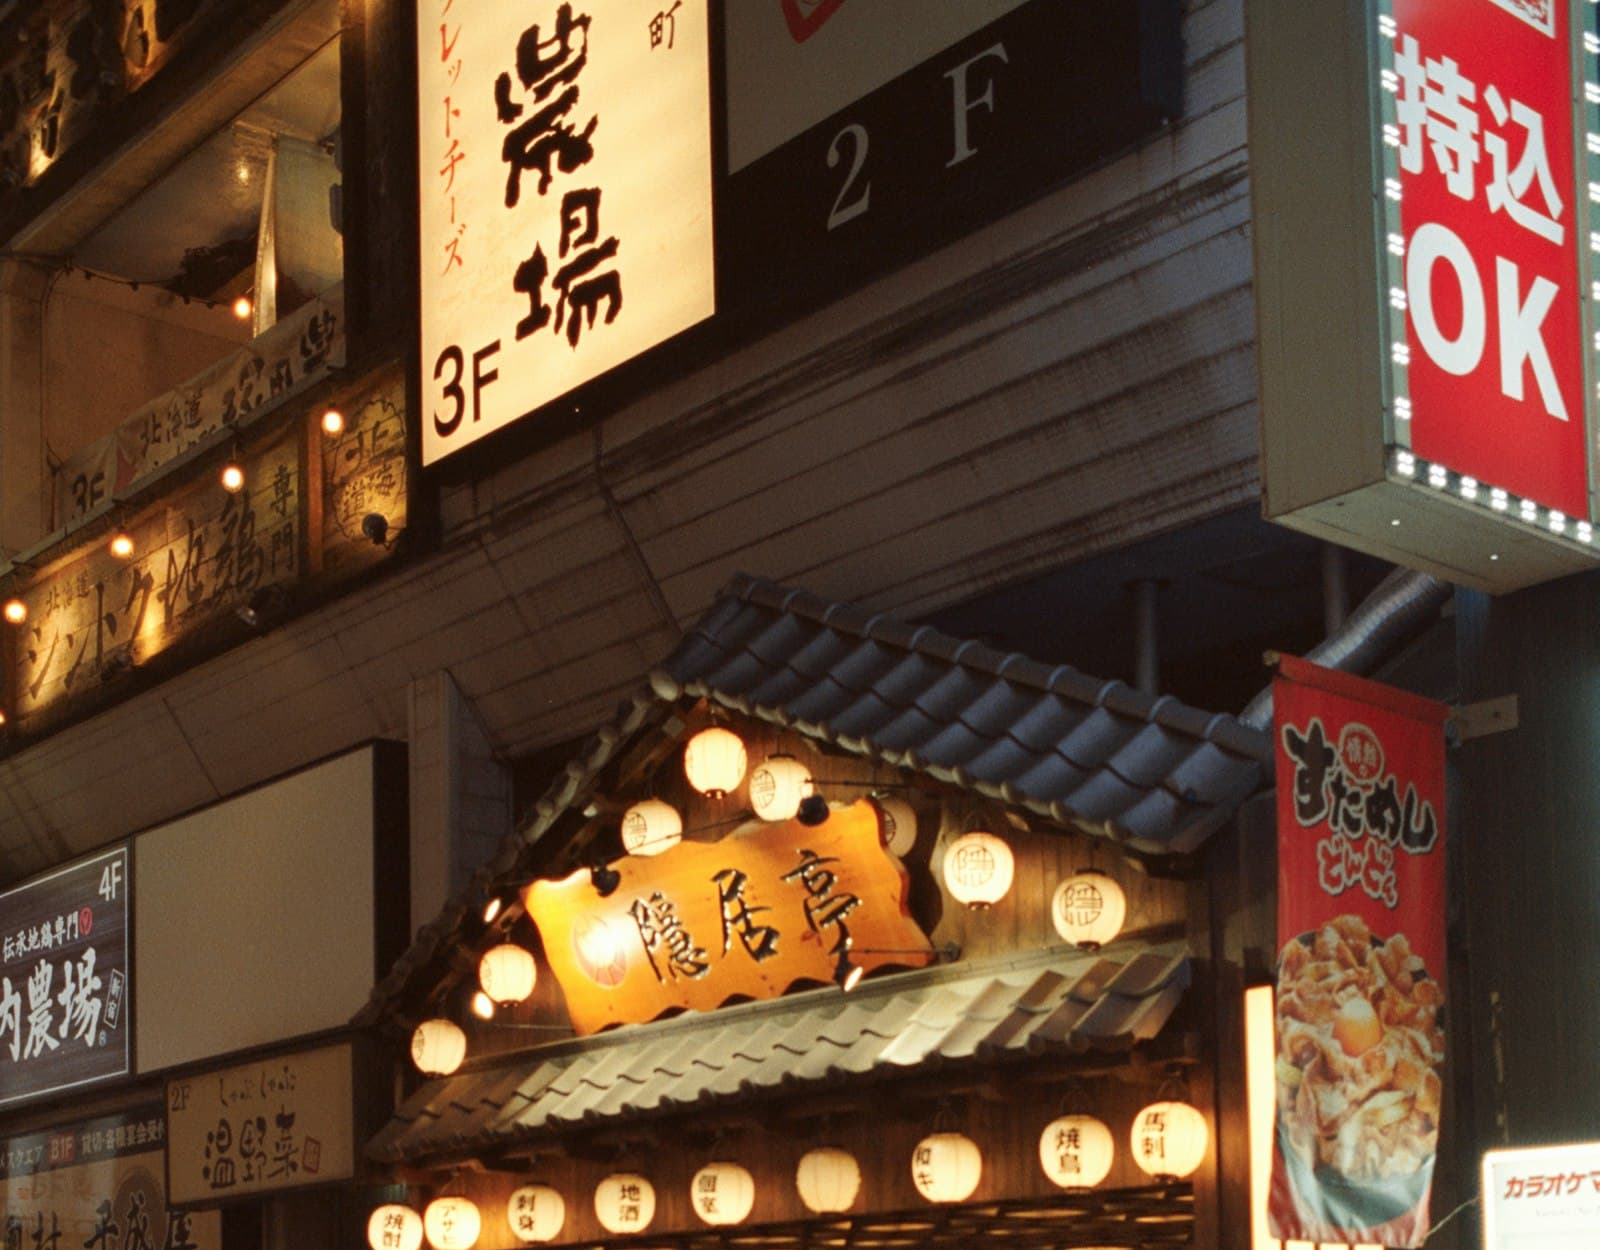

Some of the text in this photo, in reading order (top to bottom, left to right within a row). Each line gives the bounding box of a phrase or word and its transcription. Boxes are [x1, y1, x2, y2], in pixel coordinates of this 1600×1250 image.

[440, 0, 466, 277] レットチーズ
[495, 2, 623, 352] 農場
[1394, 33, 1565, 247] 持込
[1406, 222, 1569, 422] OK
[433, 339, 501, 438] 3F
[99, 860, 123, 901] 4F
[628, 849, 864, 985] 隠居亭
[171, 1084, 191, 1112] 2F
[1142, 1111, 1166, 1159] 馬刺
[203, 1103, 300, 1189] 温野菜
[1056, 1128, 1081, 1175] 焼鳥
[383, 1213, 404, 1249] 焼酎
[619, 1183, 641, 1222] 地酒
